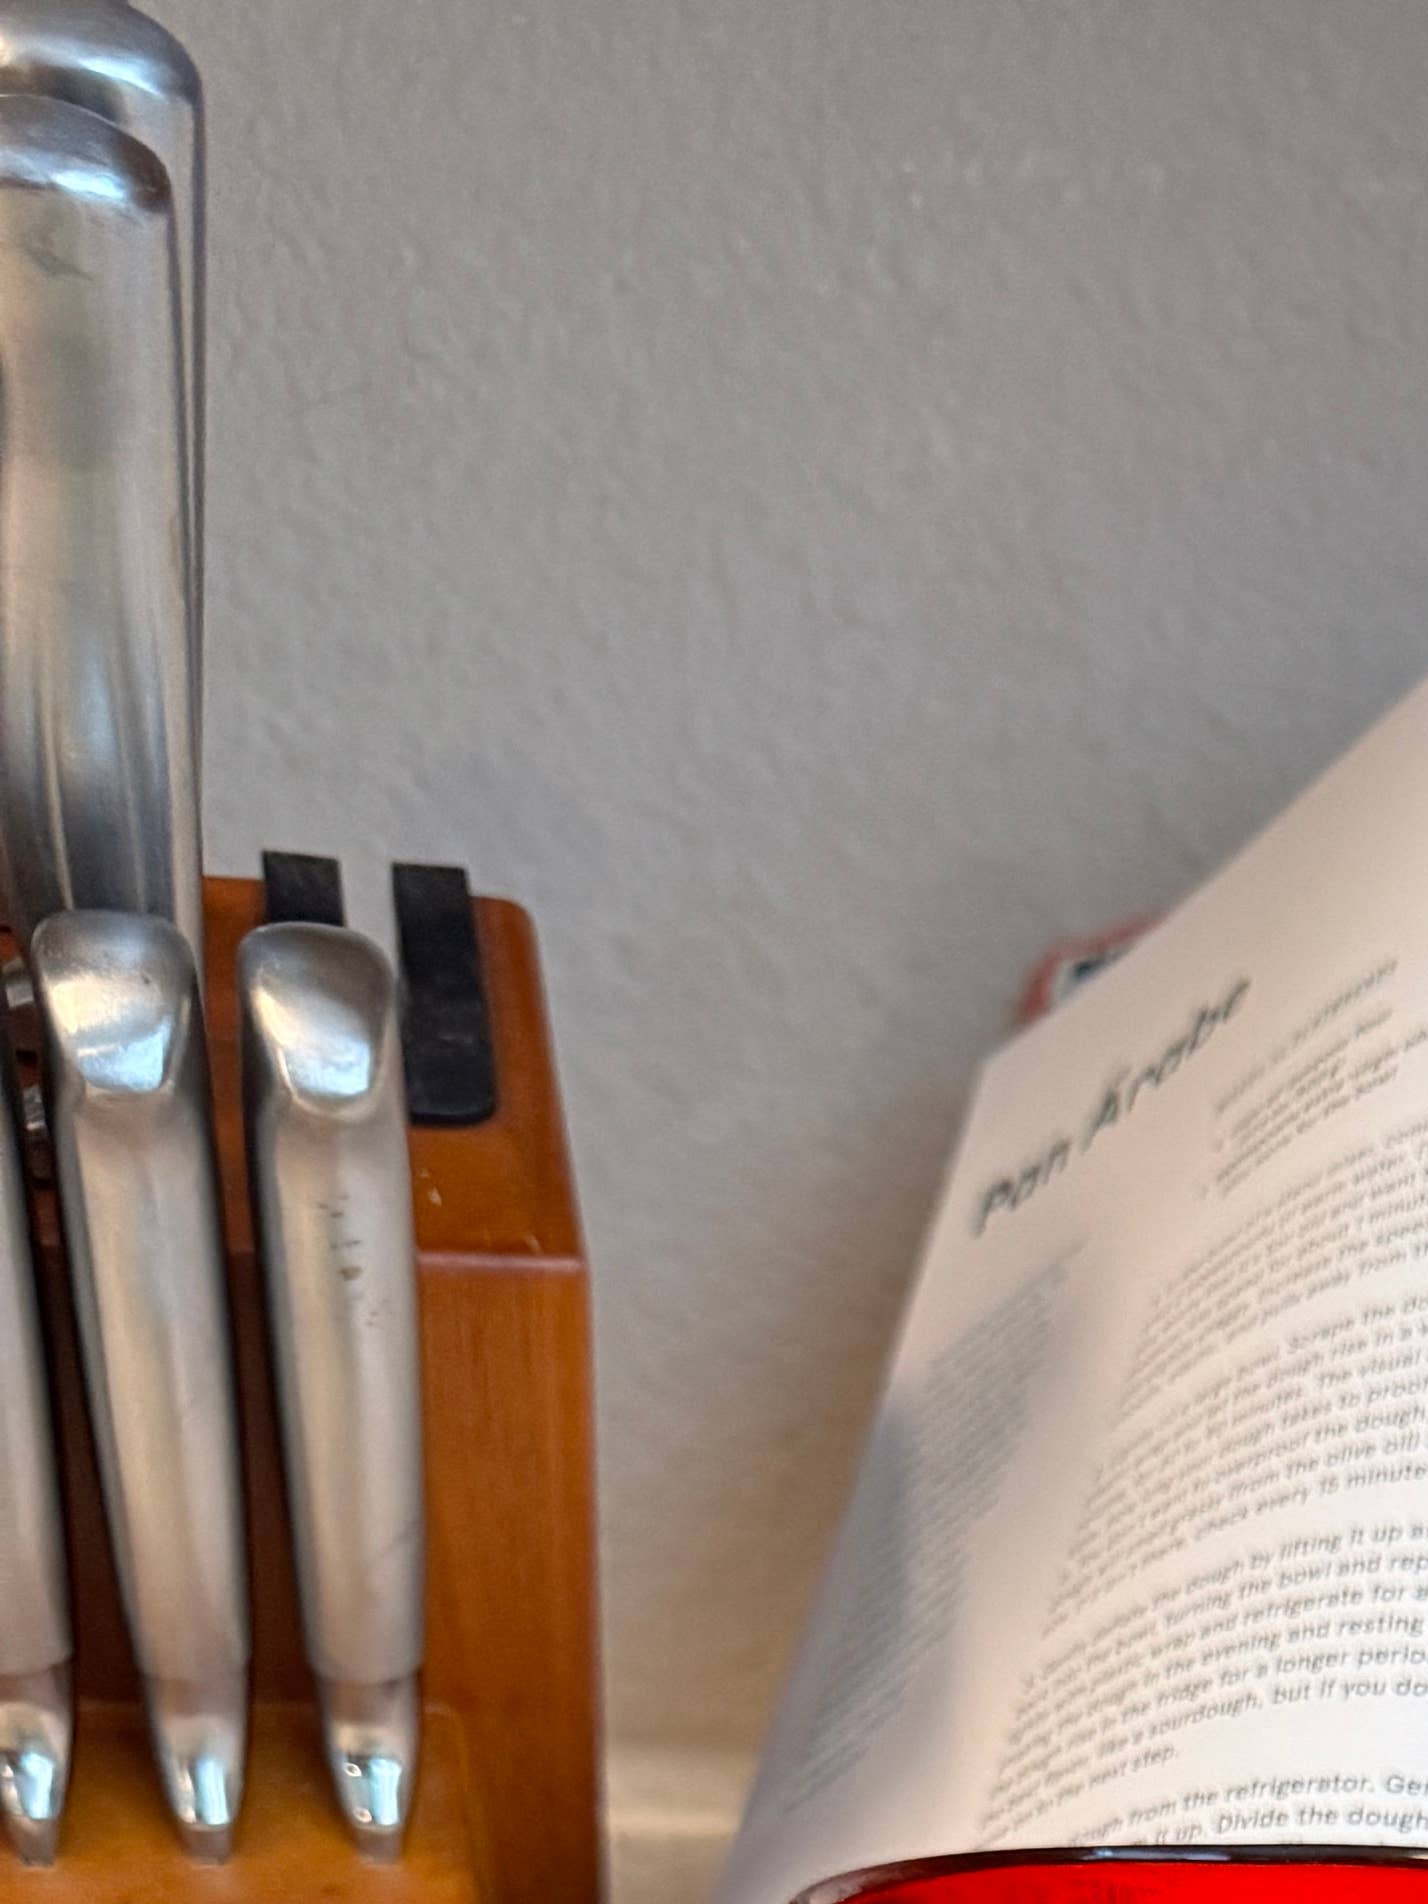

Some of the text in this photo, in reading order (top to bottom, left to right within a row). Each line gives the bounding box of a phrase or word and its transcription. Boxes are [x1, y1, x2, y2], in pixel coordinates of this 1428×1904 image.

[1372, 1522, 1404, 1547] up
[1338, 1552, 1384, 1574] and
[1371, 1583, 1406, 1602] for
[1288, 1618, 1332, 1642] and
[1338, 1610, 1425, 1638] resting
[1275, 1648, 1350, 1675] longer
[1271, 1683, 1312, 1704] but
[1318, 1680, 1342, 1700] if
[1346, 1680, 1388, 1702] you
[1225, 1775, 1375, 1802] refrigerator.
[1217, 1808, 1290, 1835] Divide
[1299, 1805, 1340, 1828] the
